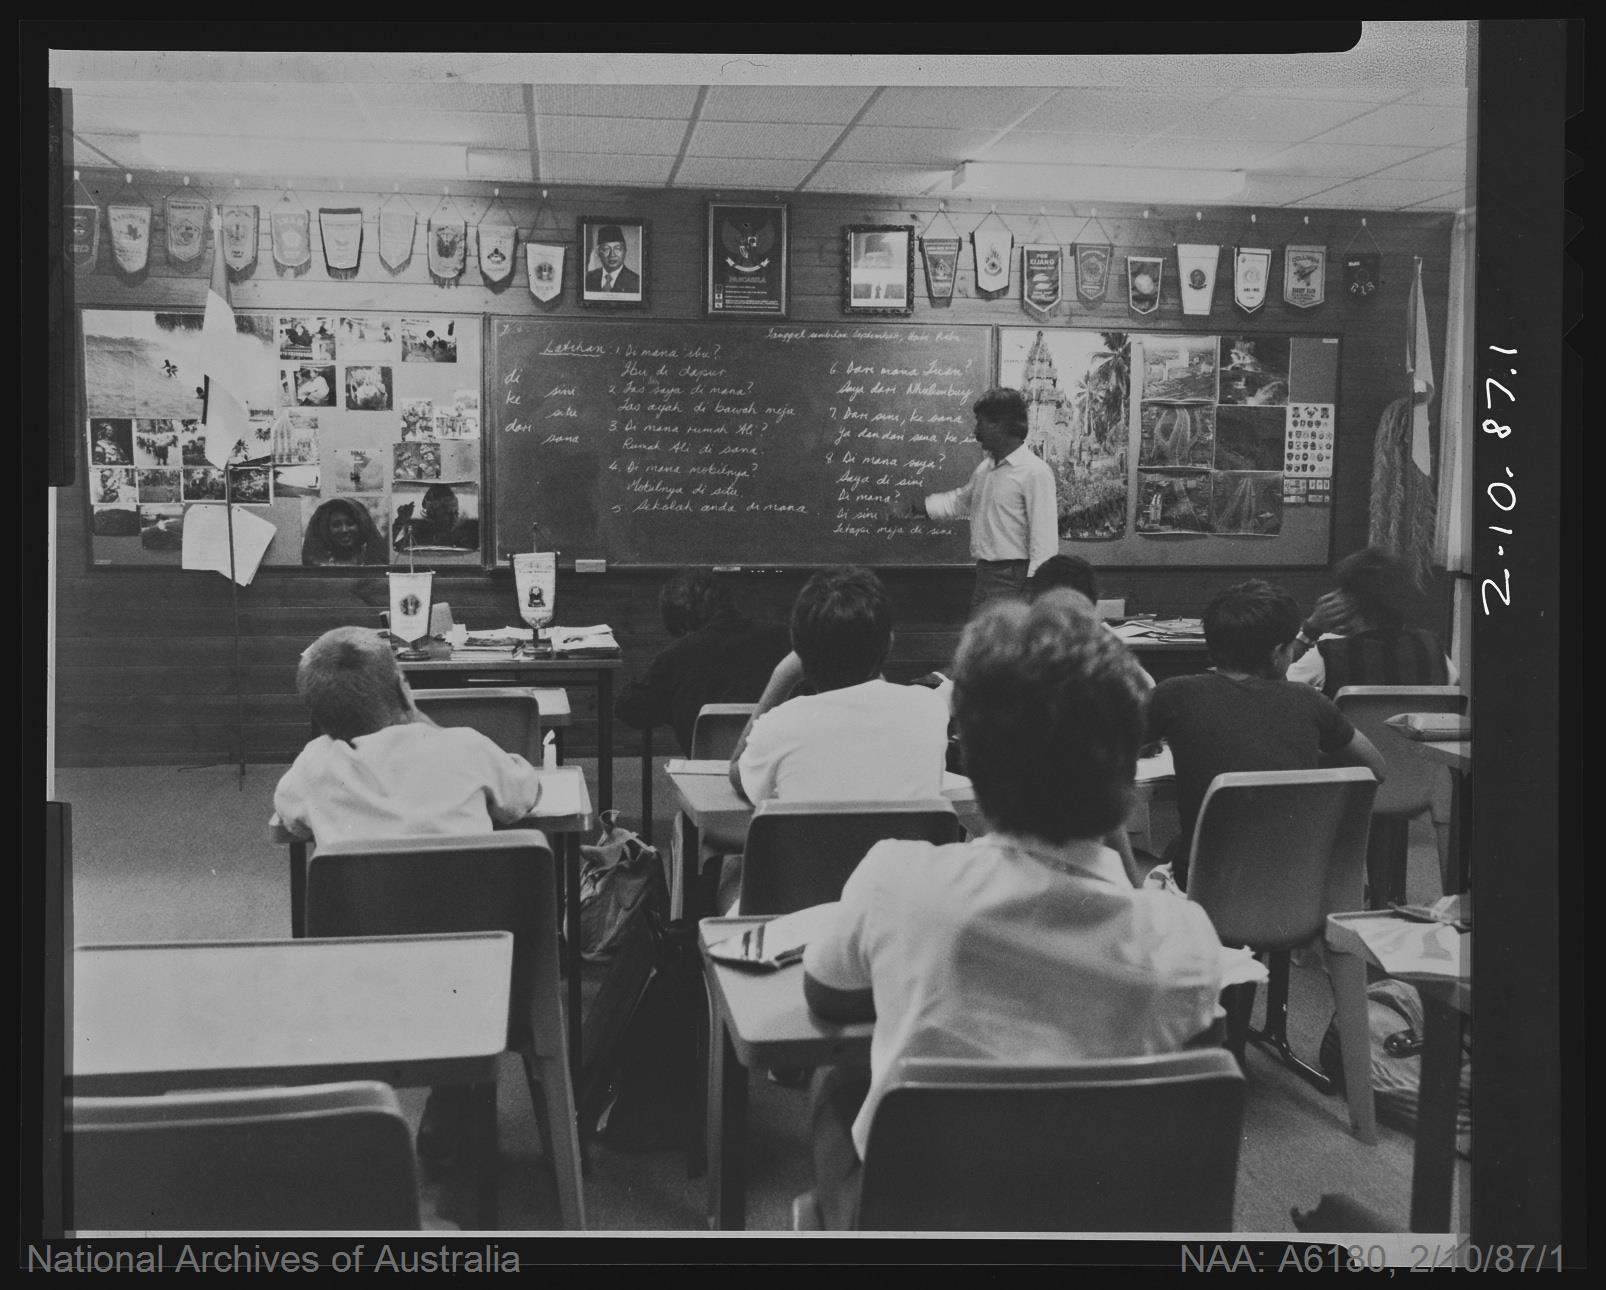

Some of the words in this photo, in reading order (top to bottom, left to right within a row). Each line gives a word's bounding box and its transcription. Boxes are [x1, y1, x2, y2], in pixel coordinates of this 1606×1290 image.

[641, 349, 679, 359] mana
[504, 367, 524, 385] di
[846, 360, 875, 375] Dari
[880, 367, 920, 377] mana
[543, 384, 577, 399] sini
[708, 380, 755, 396] mana?
[835, 379, 865, 402] Saya
[869, 380, 897, 395] dari
[505, 389, 521, 405] ke
[544, 406, 579, 420] situ
[647, 401, 684, 419] ayah
[714, 399, 758, 415] bawah
[842, 406, 869, 420] Dari
[909, 408, 924, 422] ke
[504, 418, 533, 433] dari
[643, 424, 680, 434] mana
[686, 423, 728, 434] rumah
[540, 433, 580, 446] sana
[622, 436, 662, 451] Rumah
[668, 440, 692, 454] Ali
[943, 431, 959, 443] ke
[842, 450, 858, 465] Di
[862, 456, 899, 467] mana
[645, 465, 681, 475] mana
[834, 469, 870, 493] Saya
[876, 473, 894, 486] di
[894, 475, 925, 488] sini
[855, 489, 901, 505] mana?
[631, 498, 694, 514] Sekolah
[699, 501, 737, 514] anda
[762, 503, 809, 515] mana
